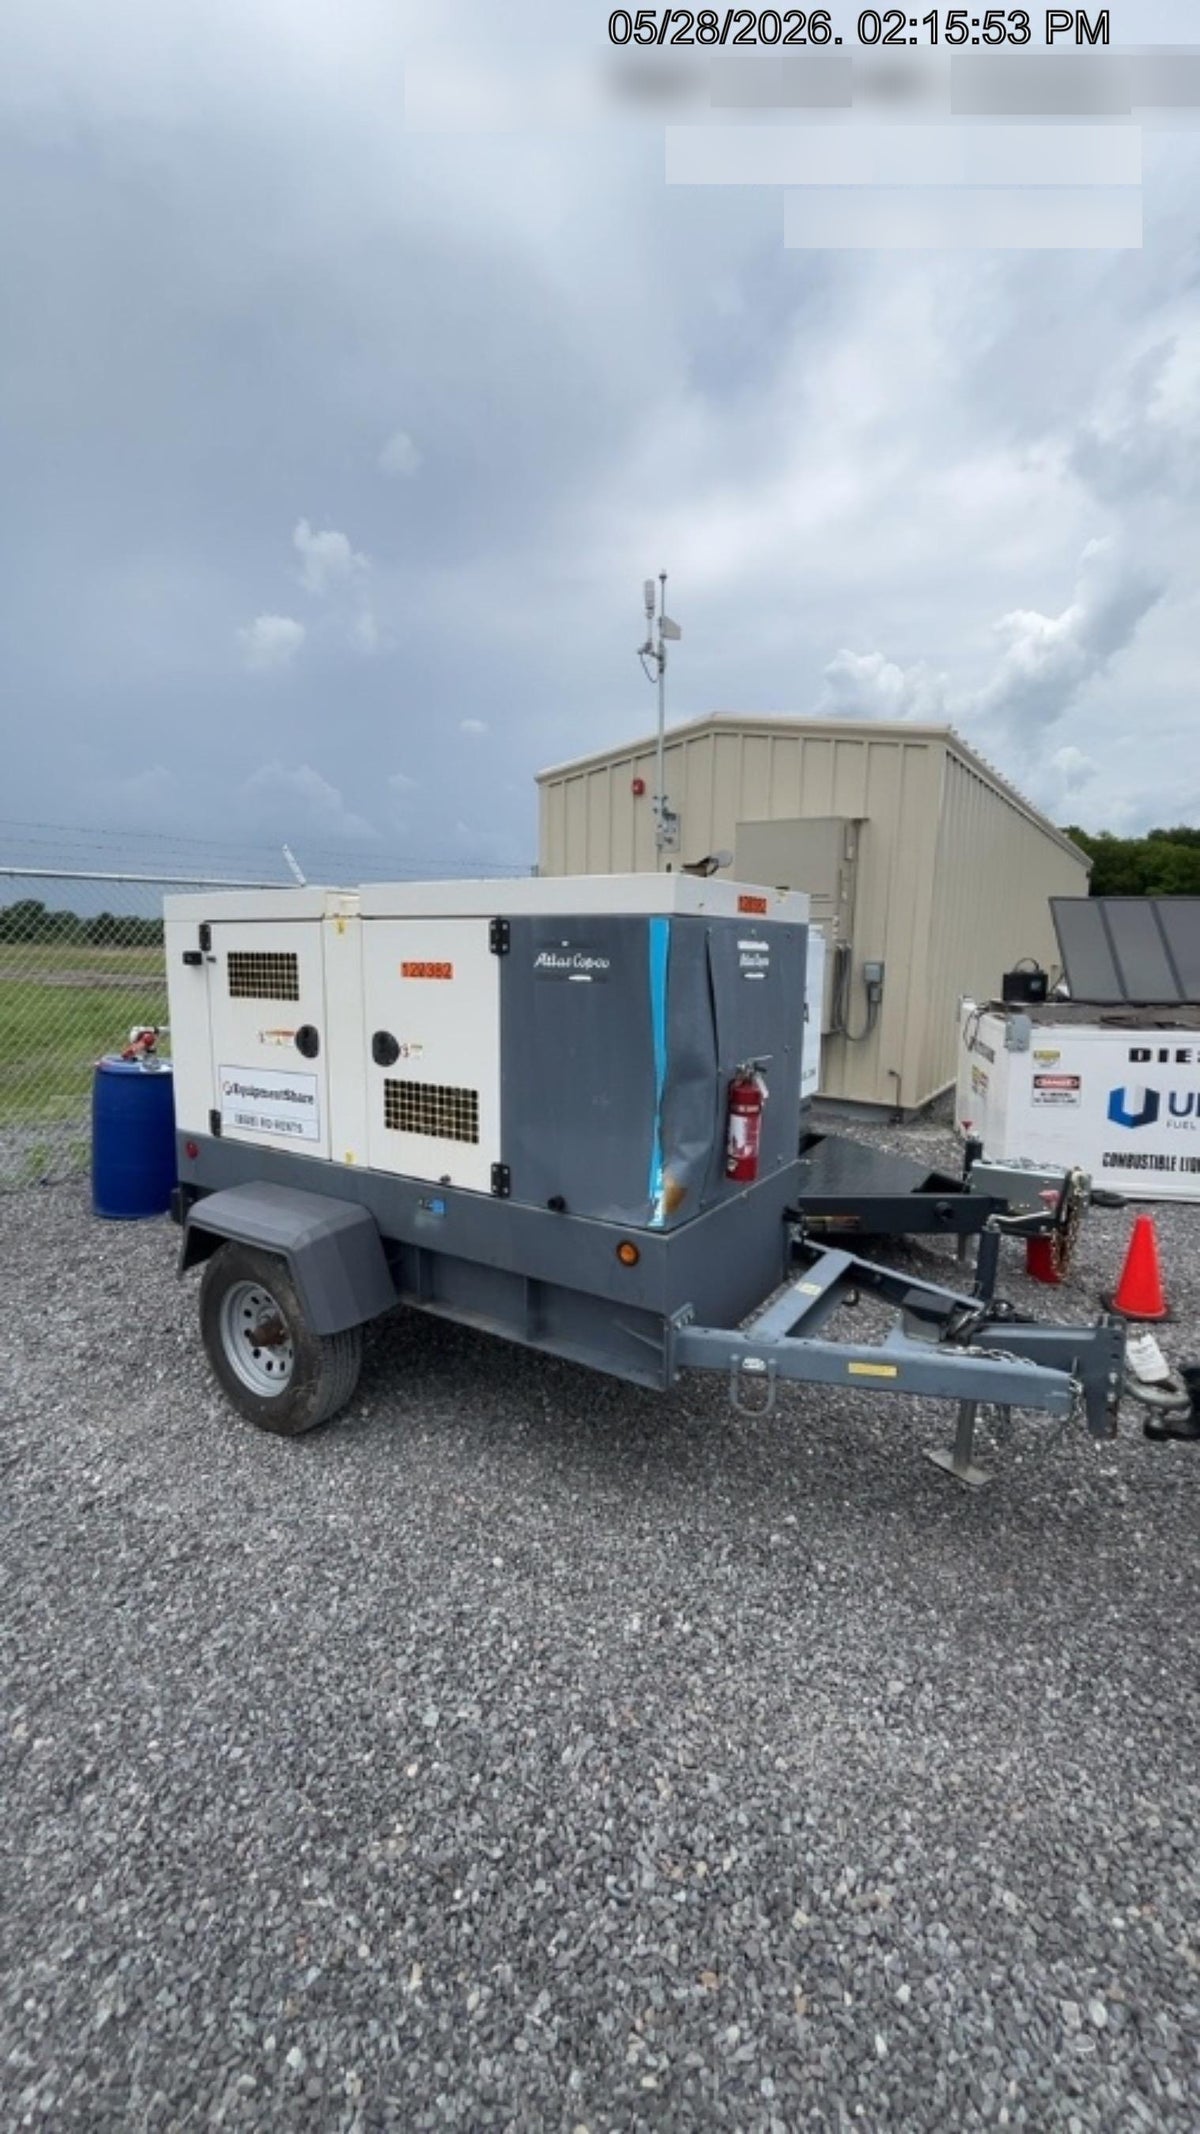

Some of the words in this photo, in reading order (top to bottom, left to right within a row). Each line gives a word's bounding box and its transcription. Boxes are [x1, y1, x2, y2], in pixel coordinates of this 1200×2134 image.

[533, 952, 571, 968] Atlas
[1168, 1091, 1200, 1118] U
[1166, 1121, 1197, 1130] FUEL
[1102, 1151, 1177, 1172] COMBUSTIBLE
